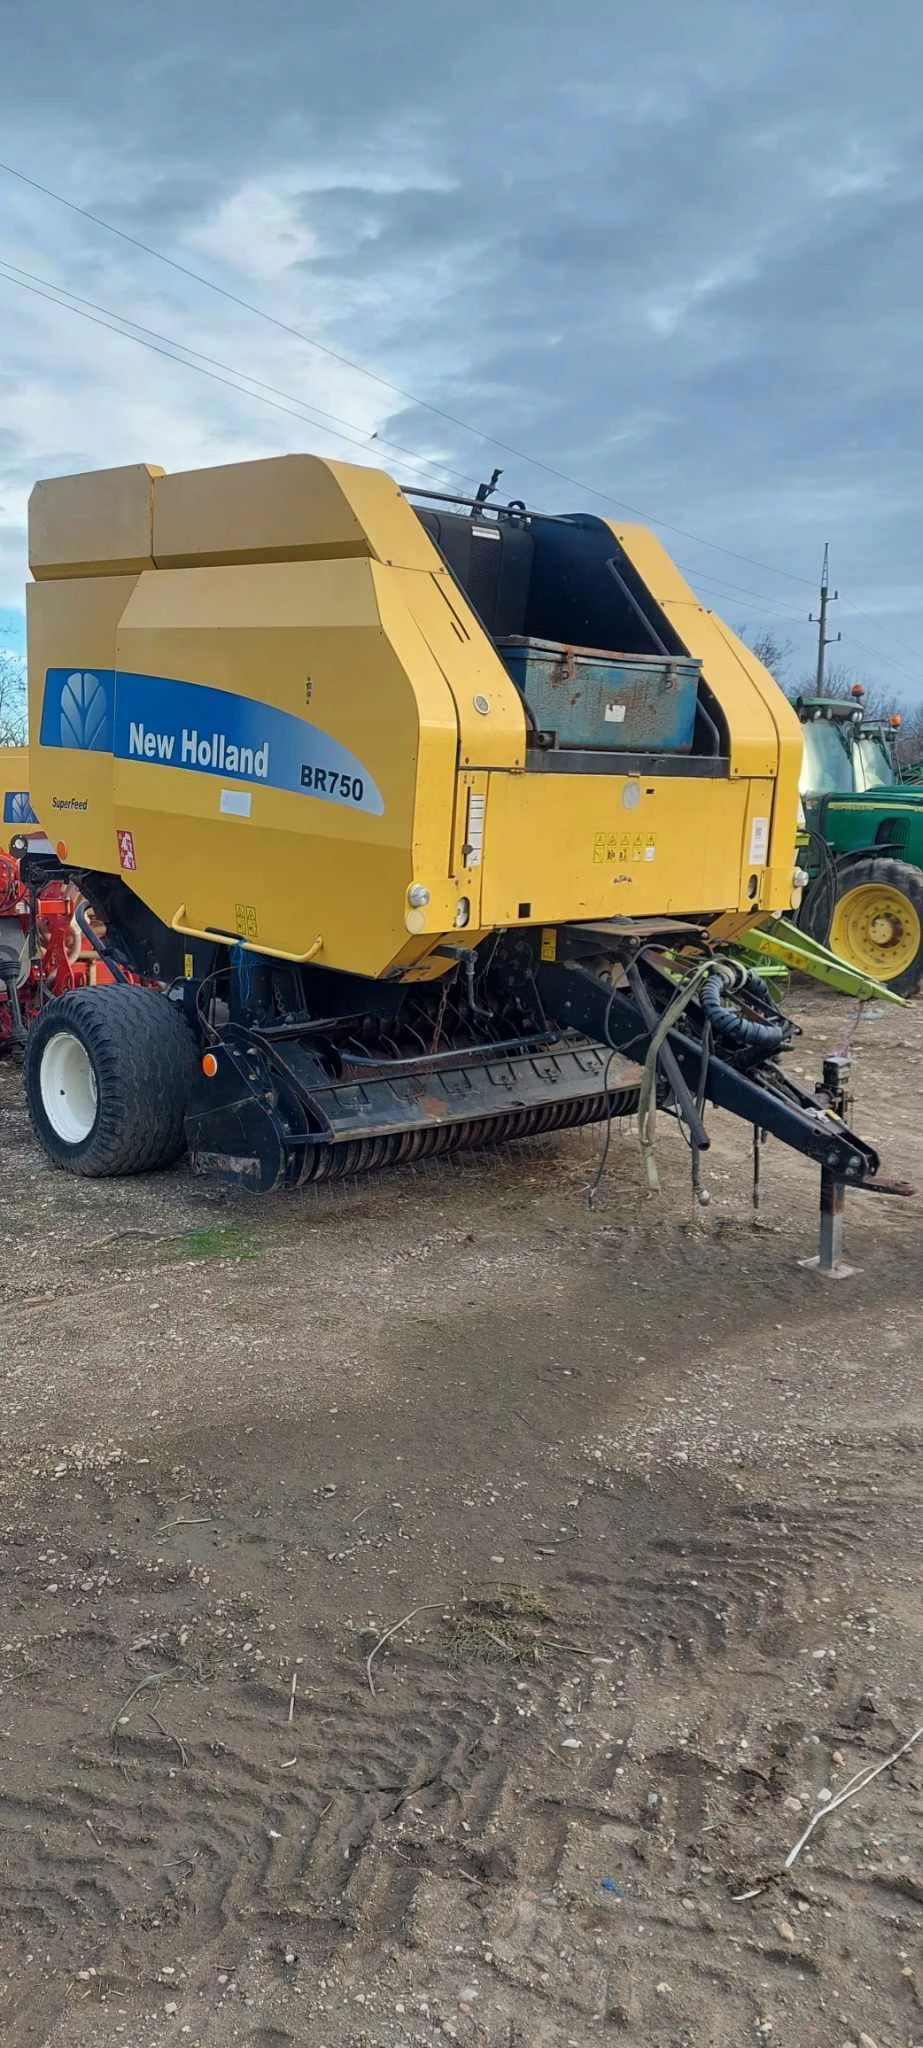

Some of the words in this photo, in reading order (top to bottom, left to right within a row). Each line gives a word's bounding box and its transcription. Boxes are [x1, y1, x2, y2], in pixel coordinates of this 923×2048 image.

[129, 722, 175, 760] New
[181, 729, 269, 777] Holland
[300, 765, 364, 801] BR750
[52, 797, 88, 811] SuperFeed
